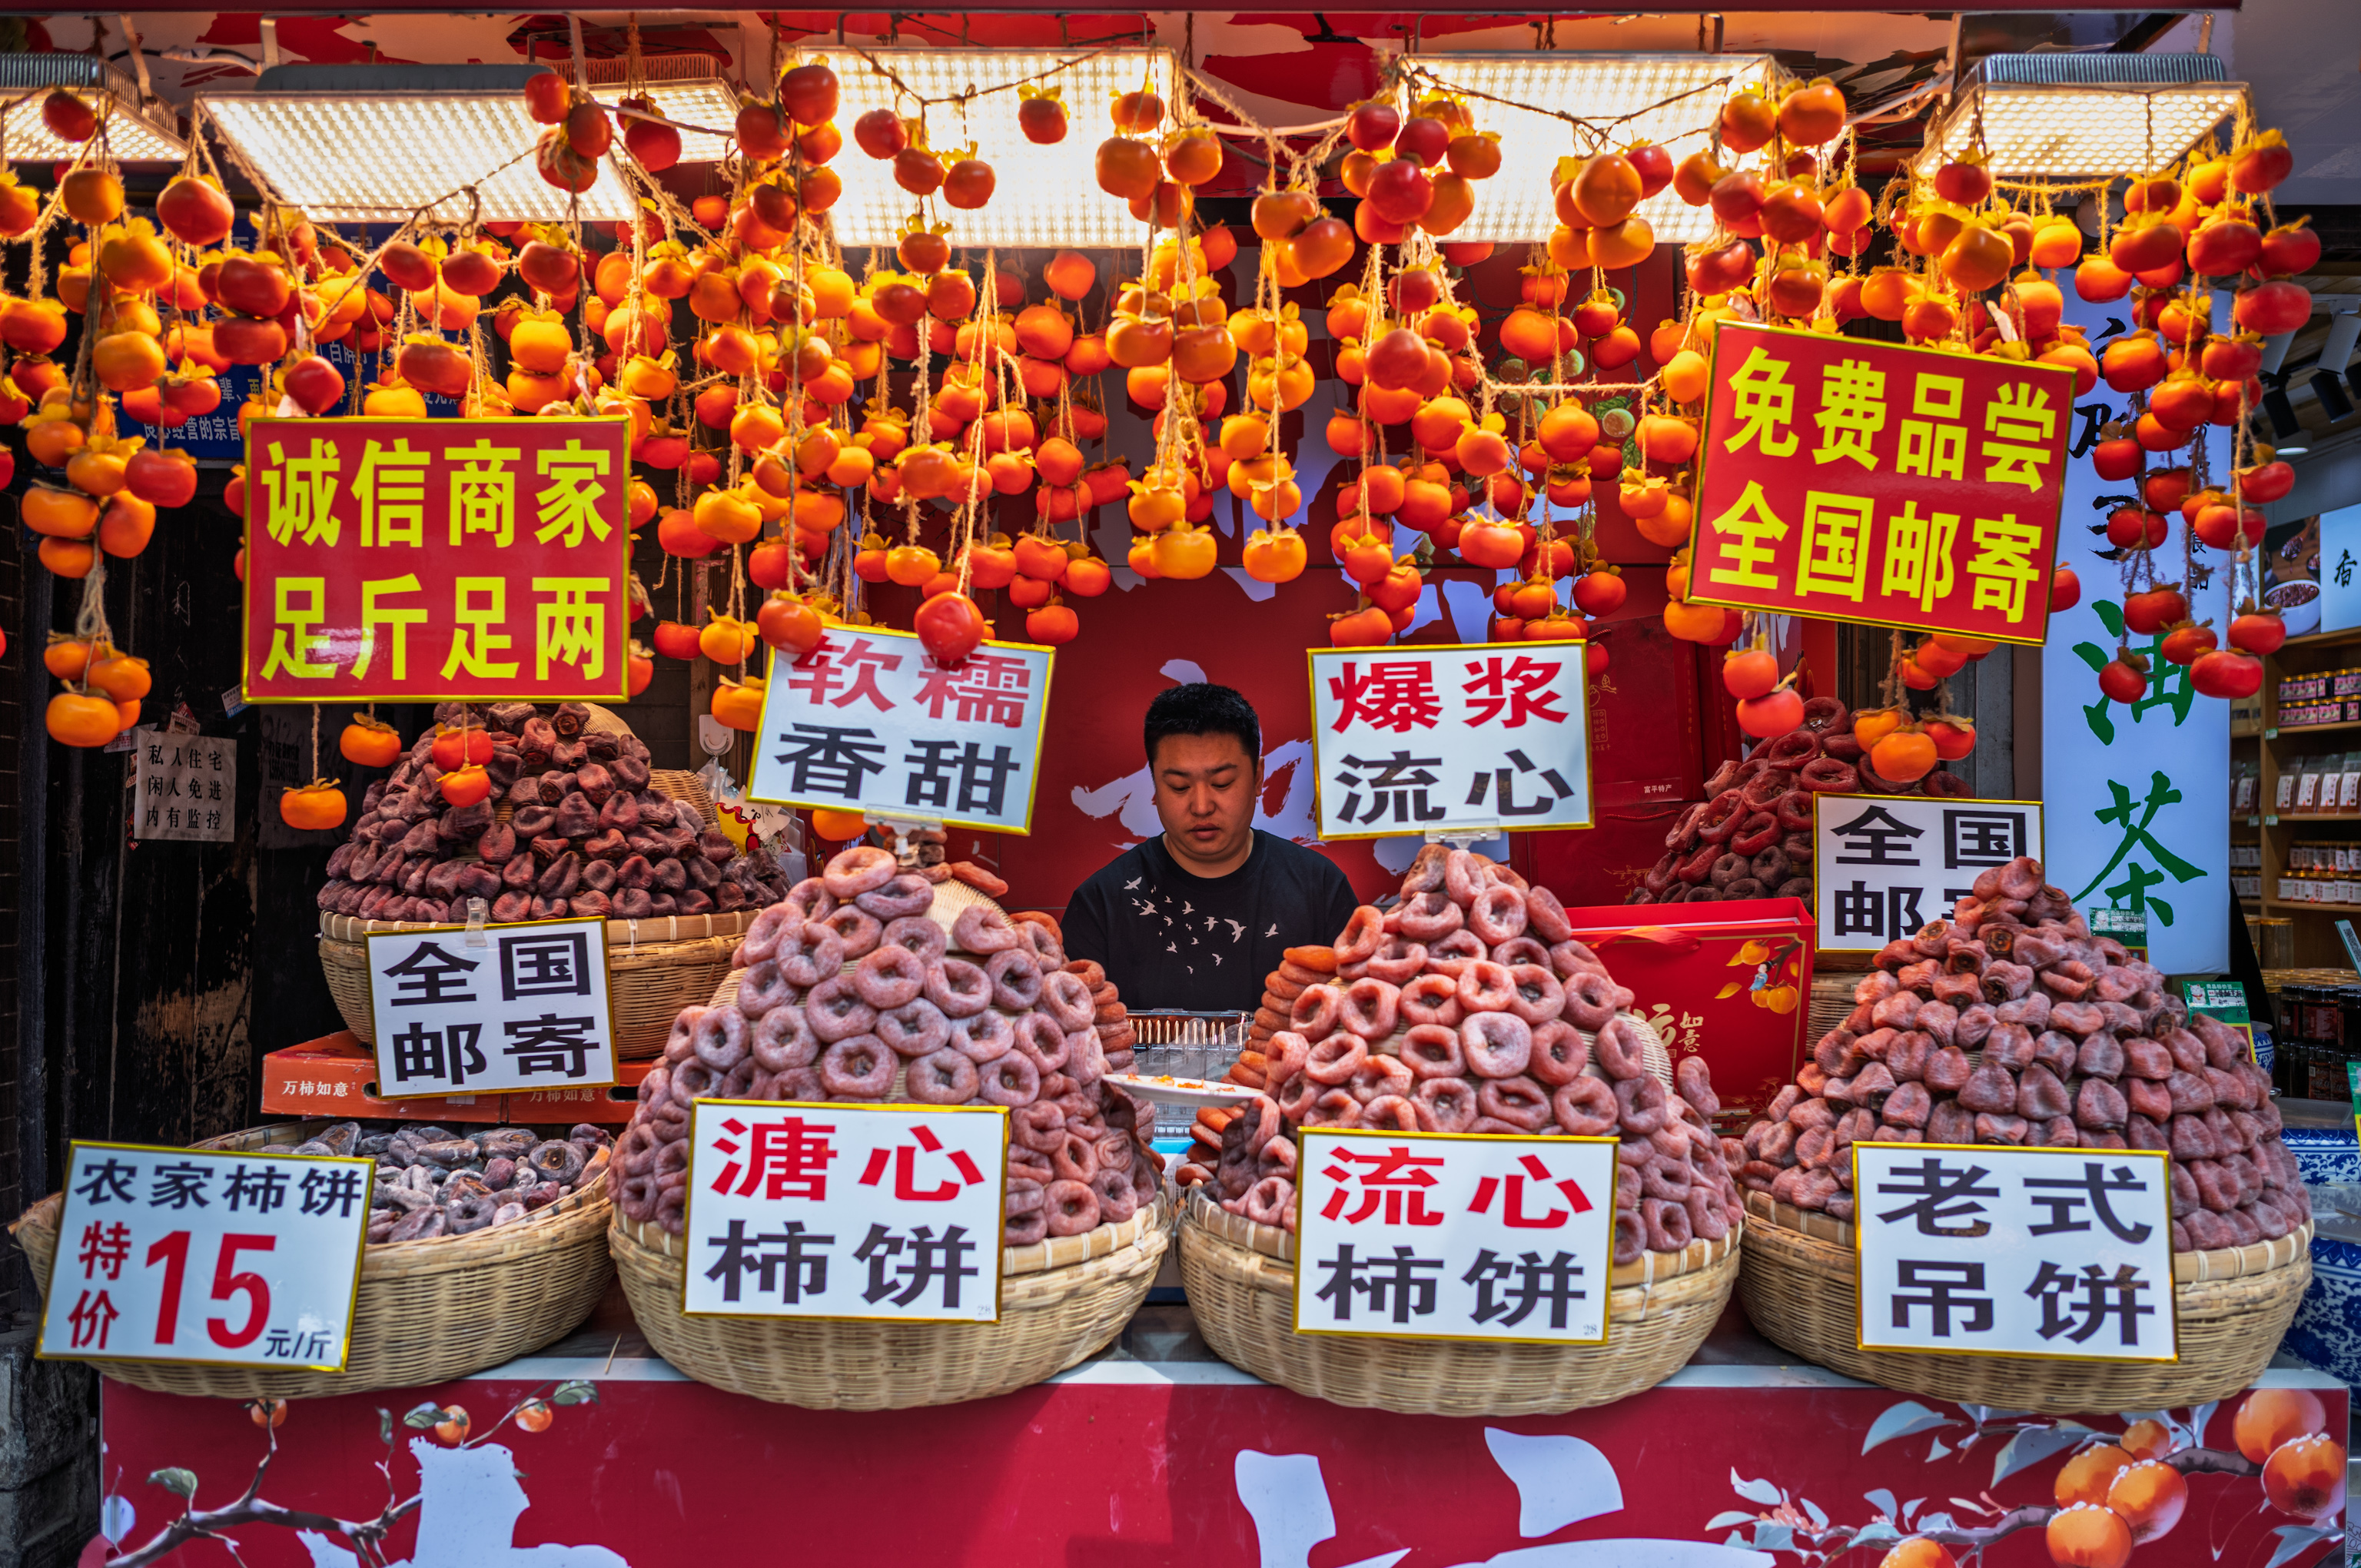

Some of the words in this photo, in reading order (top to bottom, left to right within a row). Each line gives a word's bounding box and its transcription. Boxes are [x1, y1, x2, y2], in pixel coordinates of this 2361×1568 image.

[1724, 346, 2057, 493] 免费品尝
[261, 438, 613, 548] 诚信商家
[1709, 480, 2042, 623] 全国邮寄
[261, 573, 610, 680] 足斤足两
[788, 634, 1031, 728] 软糯
[1328, 656, 1569, 733] 爆浆
[148, 745, 222, 771] 私人住宅
[148, 775, 222, 801] 闲人免进
[775, 723, 1021, 816] 香甜
[1334, 749, 1574, 825] 流心
[1644, 784, 1672, 794] 富平特产
[146, 806, 221, 830] 内有监控
[1830, 805, 2027, 869] 全国
[1835, 880, 1973, 943] 邮
[383, 932, 591, 1007] 全国
[392, 1013, 600, 1085] 邮寄
[1678, 1011, 1704, 1052] 如意
[282, 1081, 349, 1098] 万柿如意
[529, 1088, 596, 1102] 万柿如意
[75, 1158, 362, 1217] 农家柿饼
[711, 1117, 985, 1201] 溏心
[1320, 1147, 1593, 1229] 流心
[1877, 1158, 2153, 1244] 老式
[68, 1221, 131, 1350] 特价
[145, 1231, 277, 1349] 15
[264, 1329, 331, 1359] 元/斤
[705, 1219, 978, 1308] 柿饼
[1316, 1244, 1586, 1329] 柿饼
[1891, 1259, 2155, 1346] 吊饼
